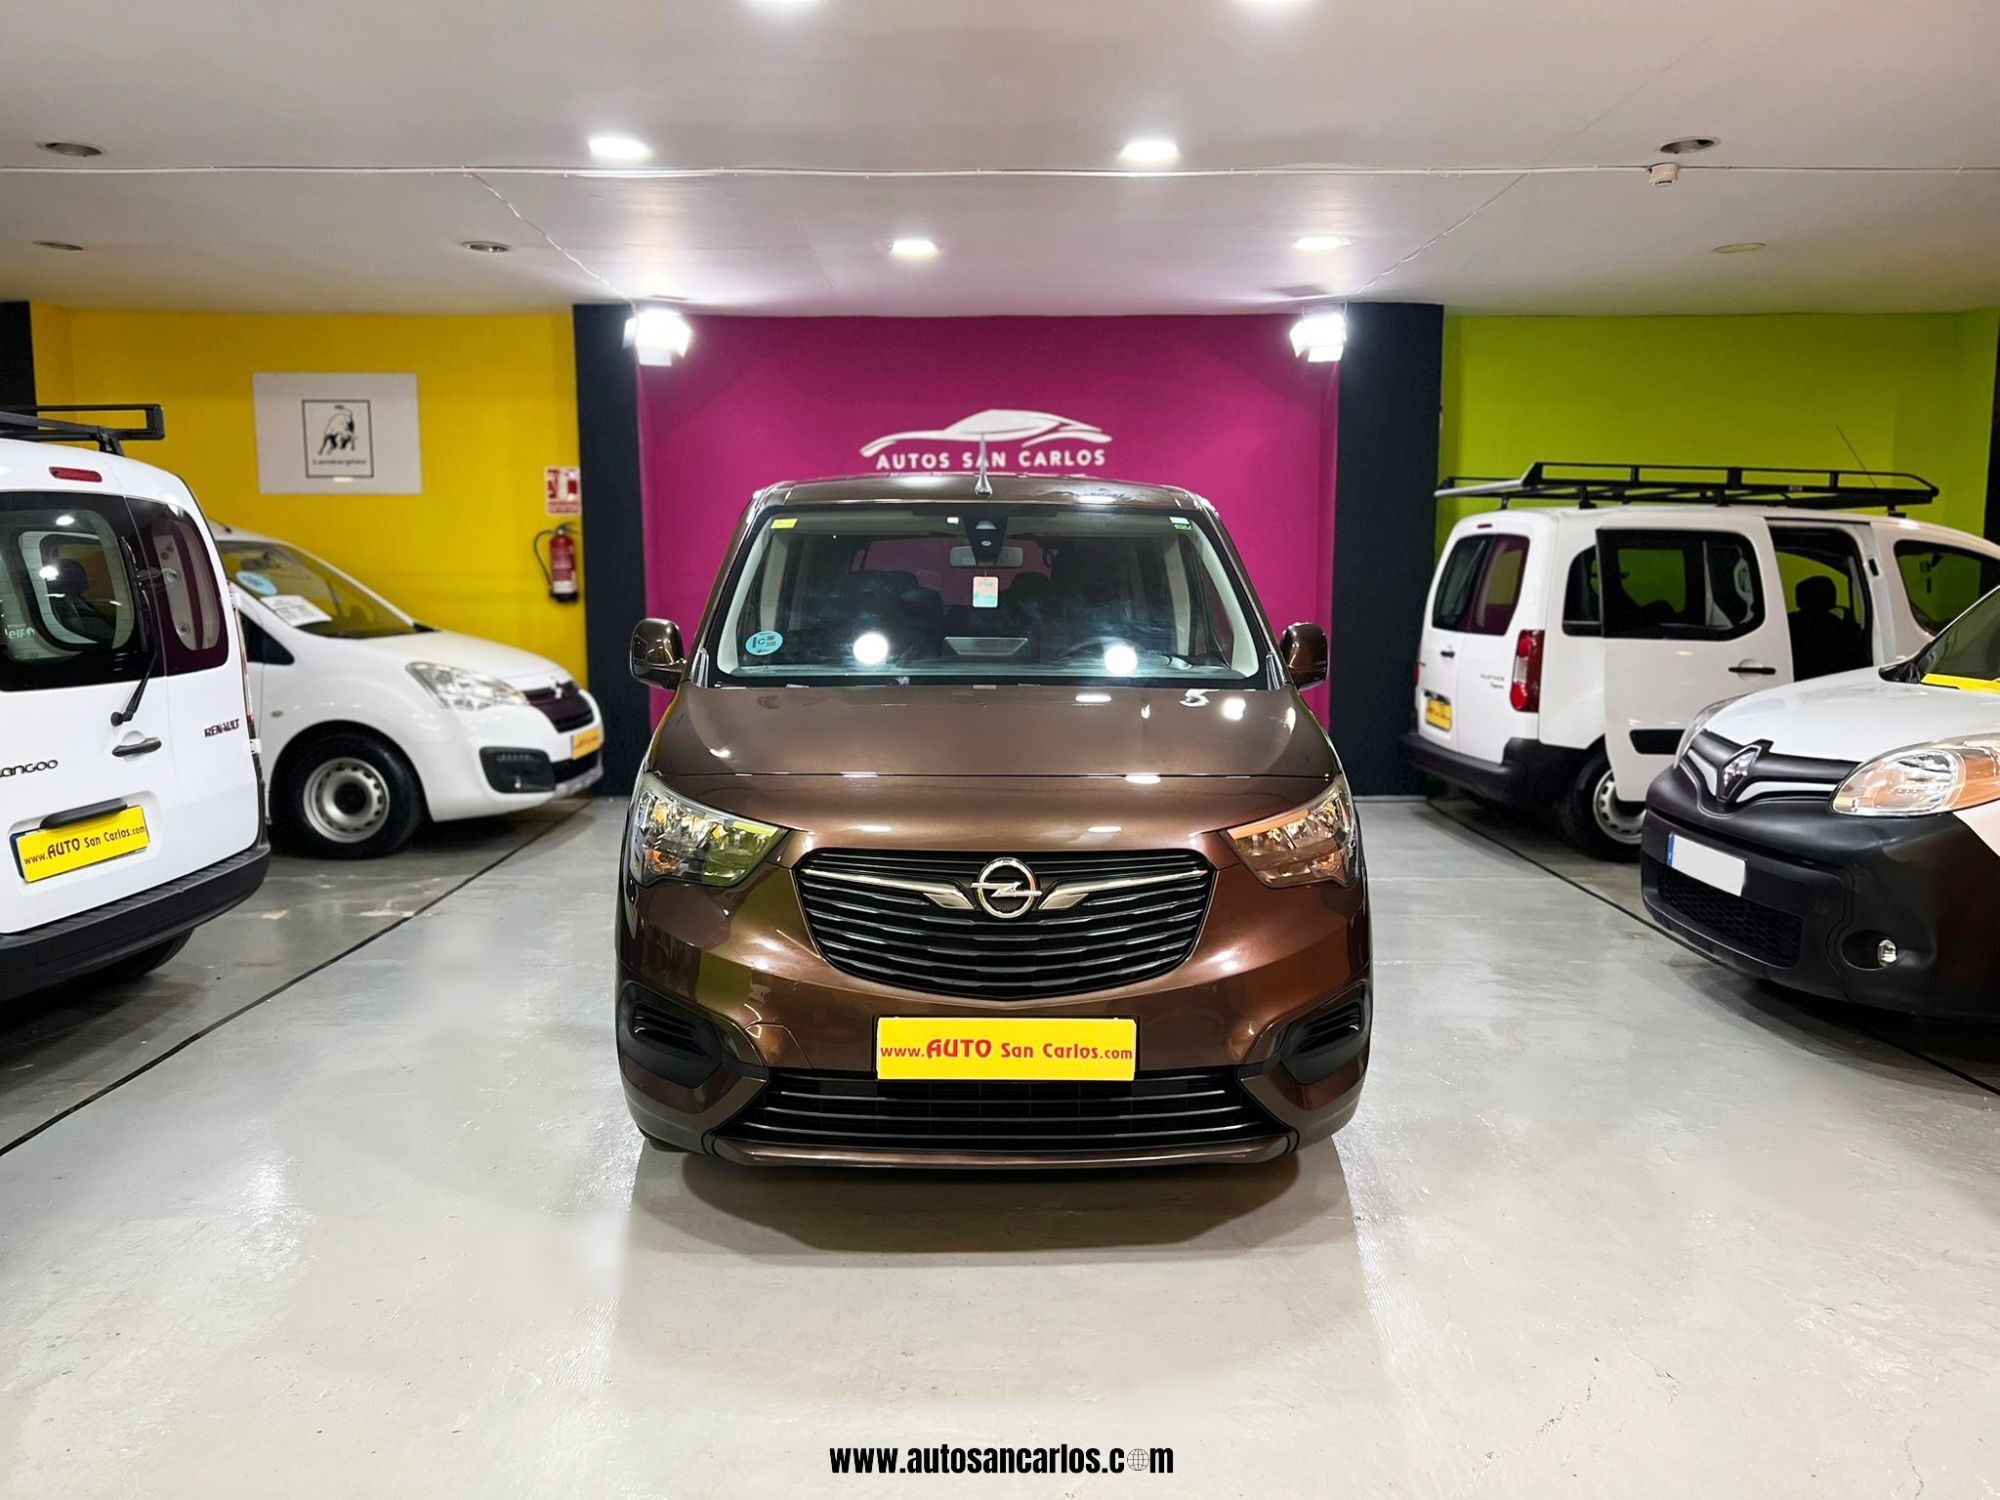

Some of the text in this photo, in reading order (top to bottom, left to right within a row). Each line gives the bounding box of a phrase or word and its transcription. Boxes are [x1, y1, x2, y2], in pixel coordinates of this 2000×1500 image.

[876, 449, 1106, 470] AUTOS SAN CARLOS
[24, 825, 146, 865] www.AUTO San Carlos.com
[881, 1039, 1133, 1060] www.AUTO San Carlos.com
